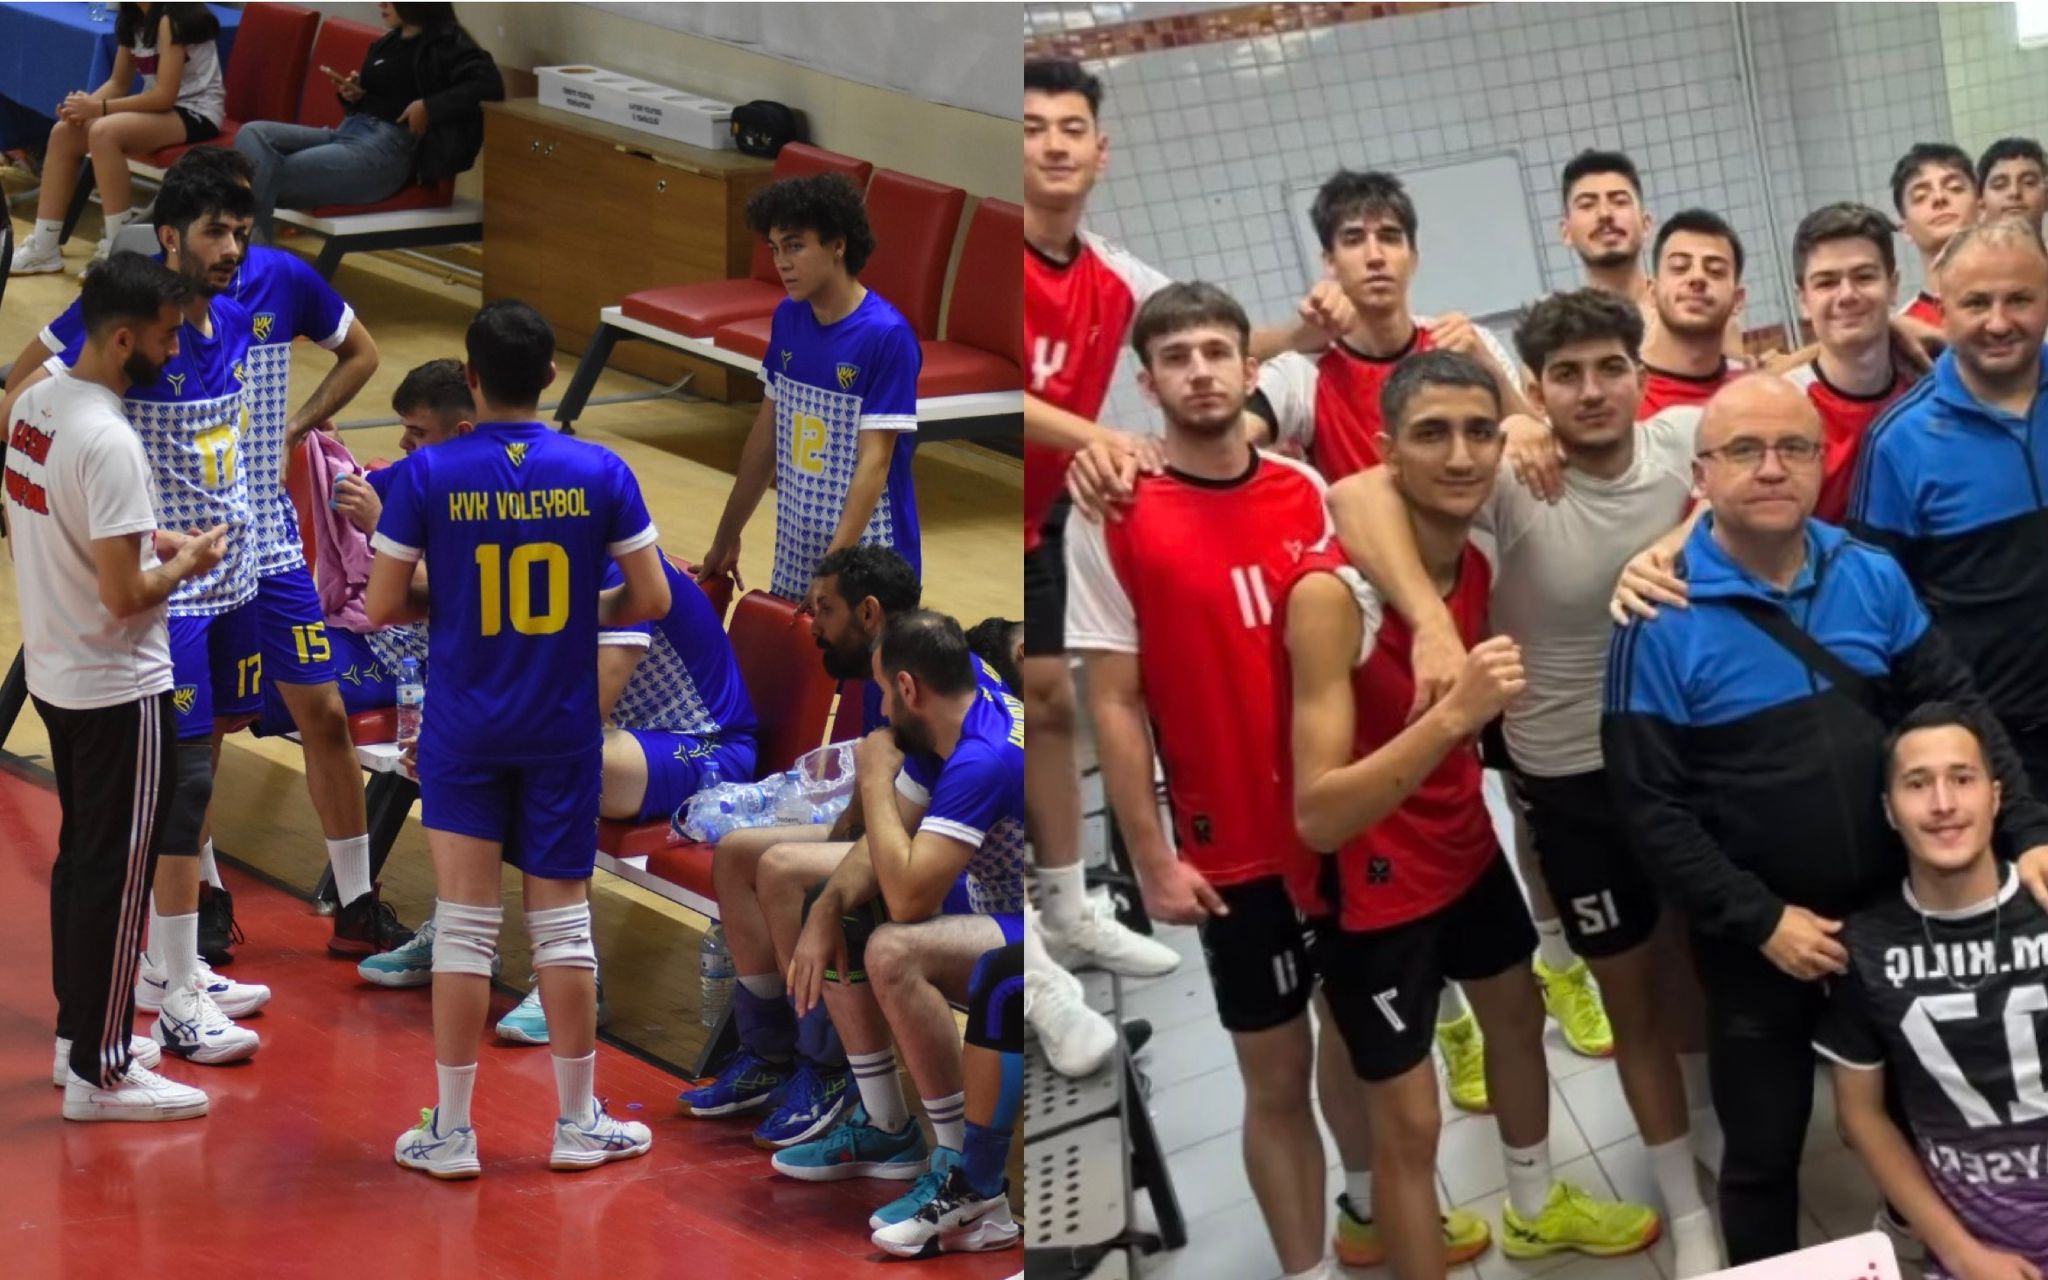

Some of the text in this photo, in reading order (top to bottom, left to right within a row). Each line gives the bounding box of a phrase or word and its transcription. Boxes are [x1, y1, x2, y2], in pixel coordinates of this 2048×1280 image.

[194, 424, 236, 488] 17
[791, 411, 826, 473] 12
[449, 488, 590, 521] KVK VOLEYBOL
[475, 542, 570, 637] 10
[292, 621, 331, 664] 15
[237, 652, 262, 698] 17
